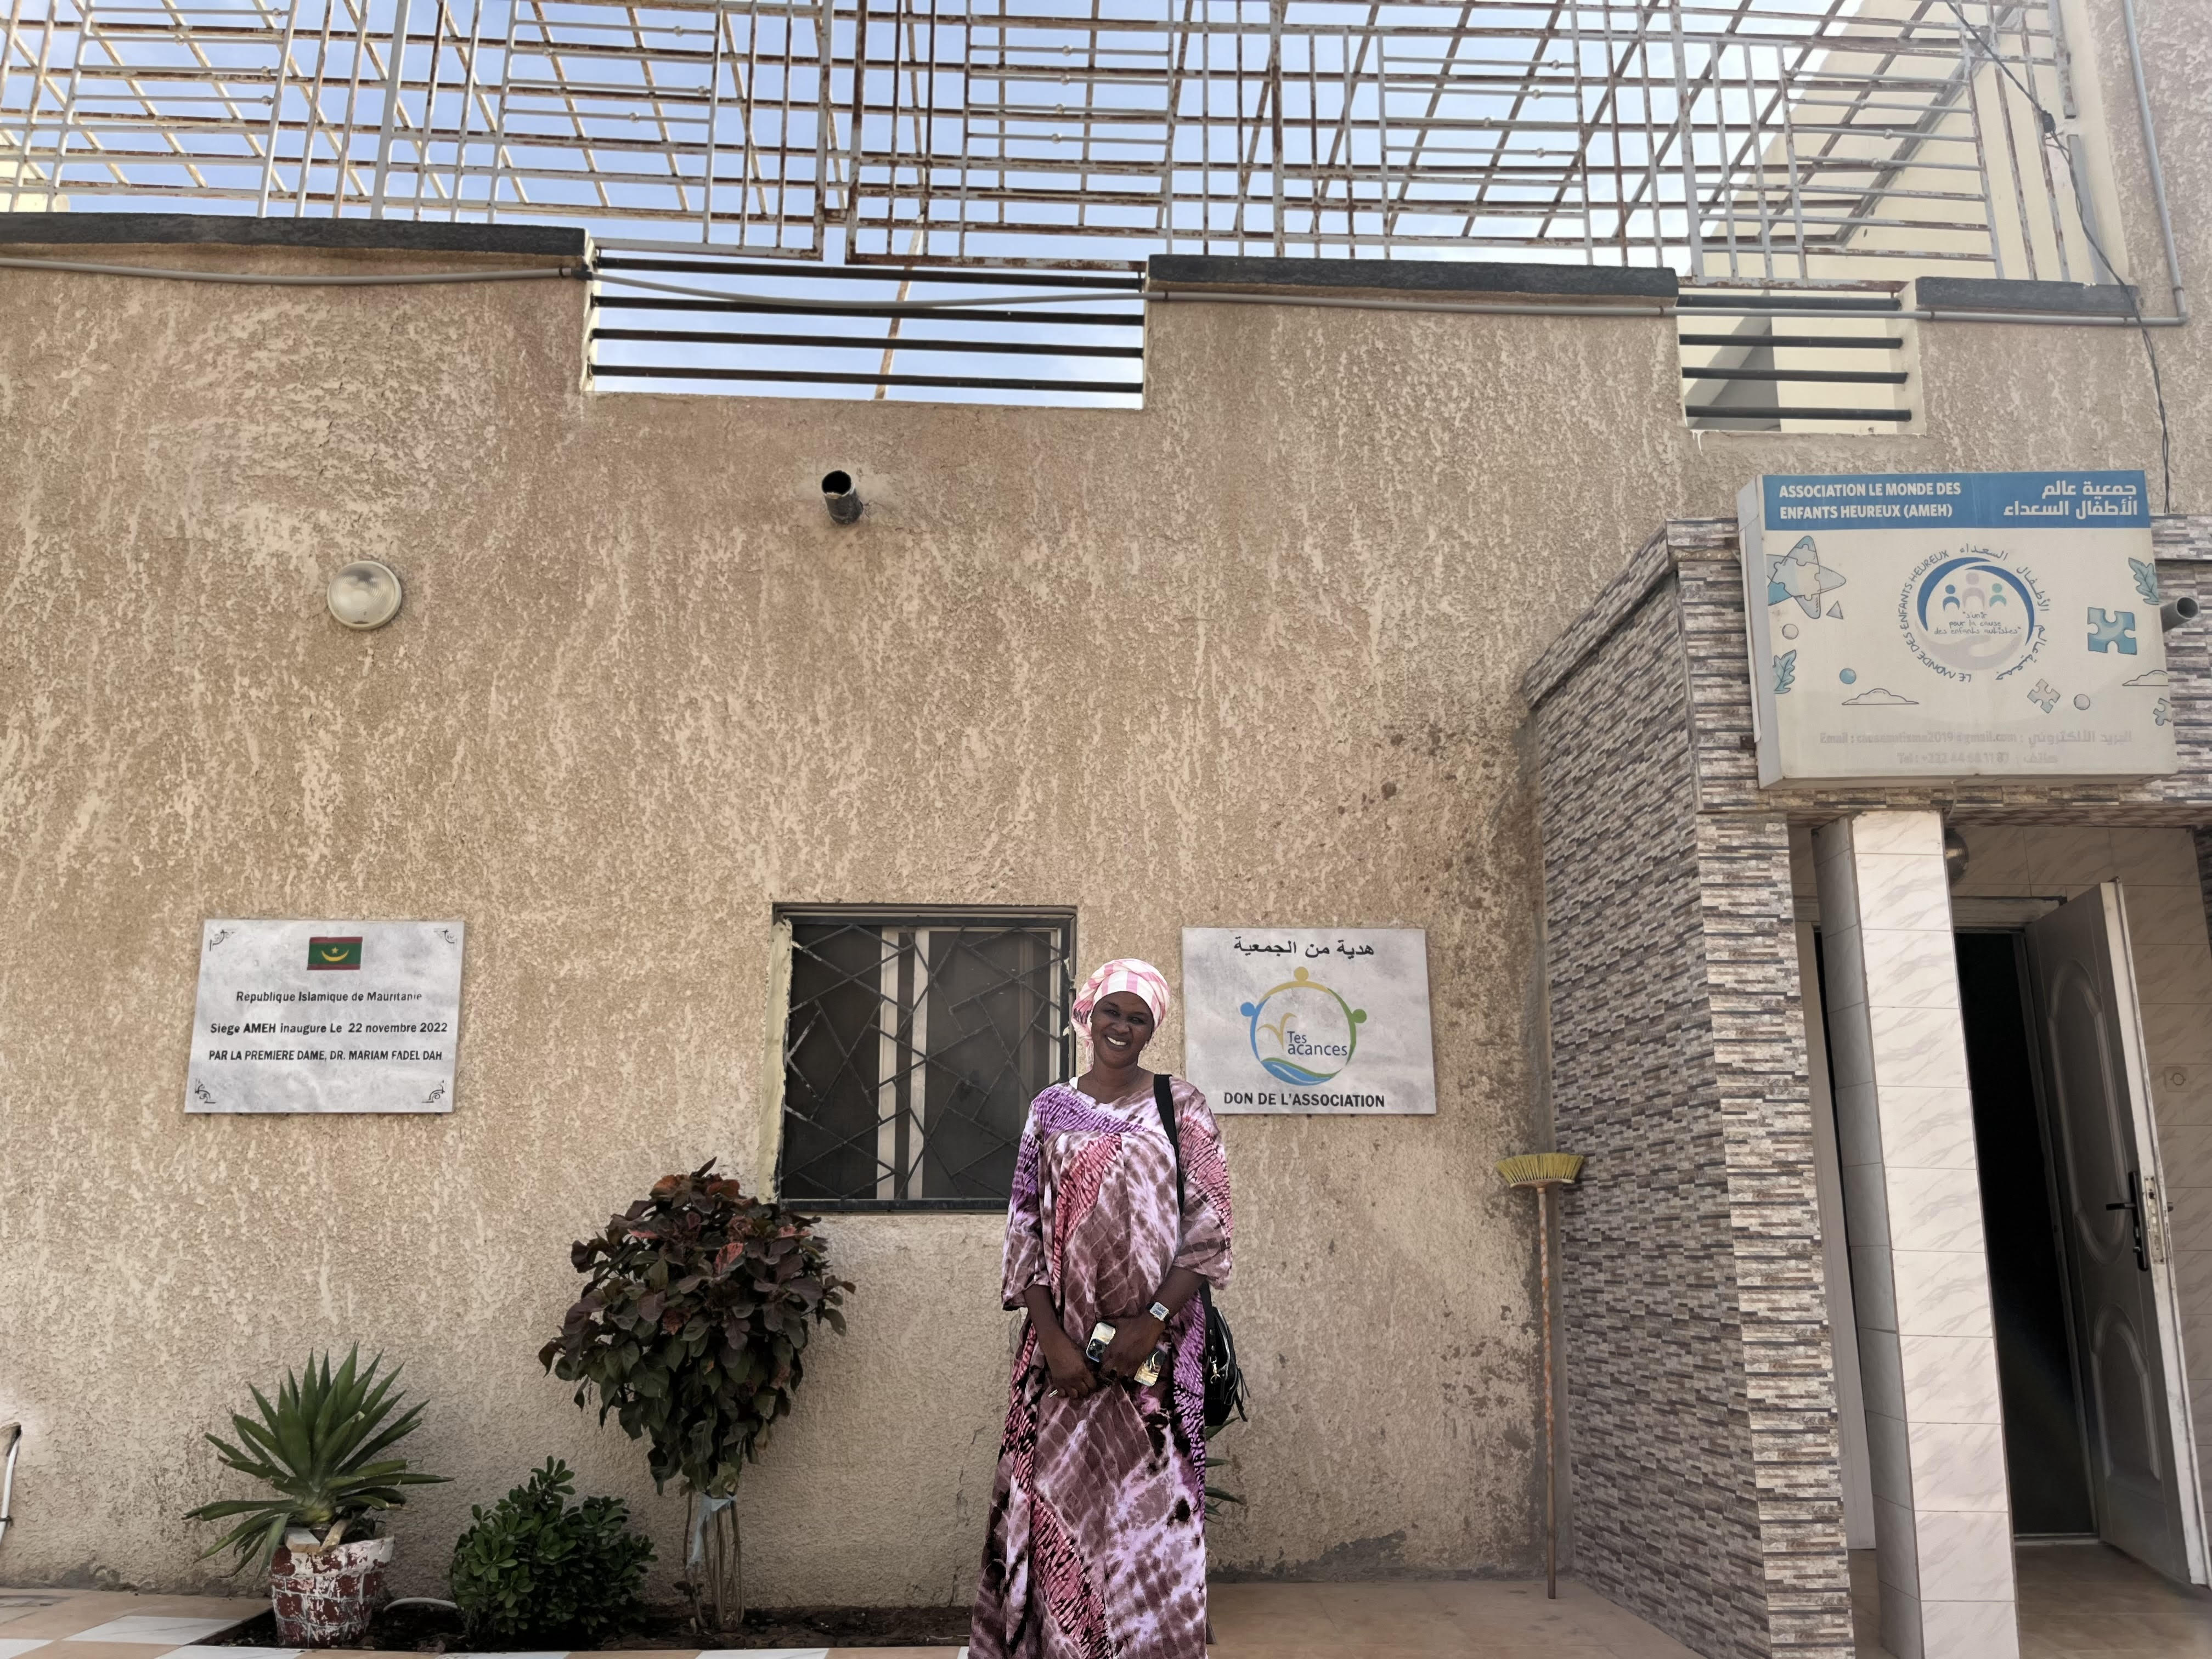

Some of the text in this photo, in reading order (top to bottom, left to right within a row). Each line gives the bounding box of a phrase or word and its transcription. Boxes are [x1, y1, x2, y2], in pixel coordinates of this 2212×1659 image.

[1779, 482, 1961, 498] ASSOCIATION LE MONDE DES
[2041, 480, 2136, 500] جمعية عالم
[1780, 504, 1953, 519] ENFANTS HEUREUX (AMEH)
[2004, 498, 2137, 520] الأطفال السعداء
[1960, 543, 2008, 561] السعداء
[1898, 550, 1971, 682] LE MONDE DES ENFANTS HEUREUX
[1234, 936, 1374, 960] هدية من الجمعية
[298, 991, 348, 1003] Islamique
[352, 992, 364, 1001] de
[367, 992, 421, 1001] Mauritanie
[243, 1023, 276, 1033] AMEH
[330, 1023, 342, 1033] Le
[348, 1023, 362, 1032] 22
[366, 1023, 416, 1032] novembre
[420, 1023, 447, 1032] 2022
[1287, 1031, 1306, 1045] Tes
[209, 1050, 228, 1060] PAR
[230, 1051, 242, 1060] LA
[297, 1051, 326, 1062] DAME,
[330, 1051, 345, 1060] DR.
[349, 1050, 388, 1060] MARIAM
[392, 1051, 420, 1060] FADEL
[423, 1051, 442, 1060] DAH
[1224, 1092, 1384, 1107] DON DE L'ASSOCIATION
